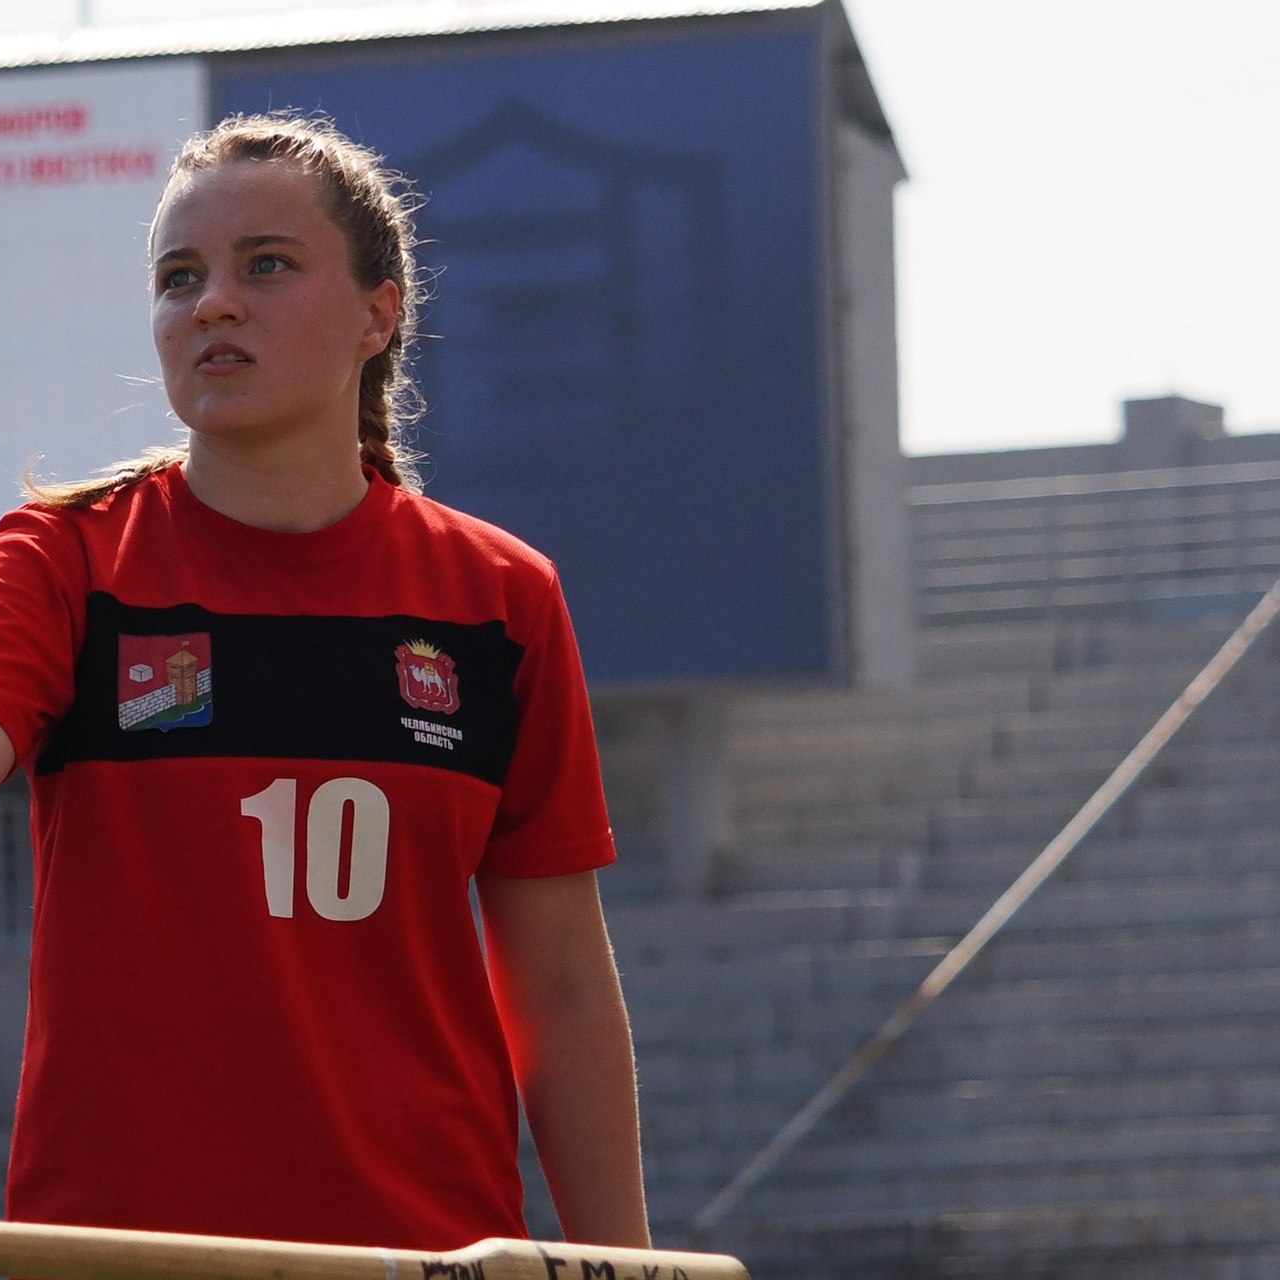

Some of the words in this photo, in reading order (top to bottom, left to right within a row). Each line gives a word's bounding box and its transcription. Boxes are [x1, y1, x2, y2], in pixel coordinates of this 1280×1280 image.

[400, 717, 463, 741] ЧЕЛЯБИНСКАЯ
[413, 731, 454, 751] ОБЛАСТЬ
[240, 777, 390, 921] 10
